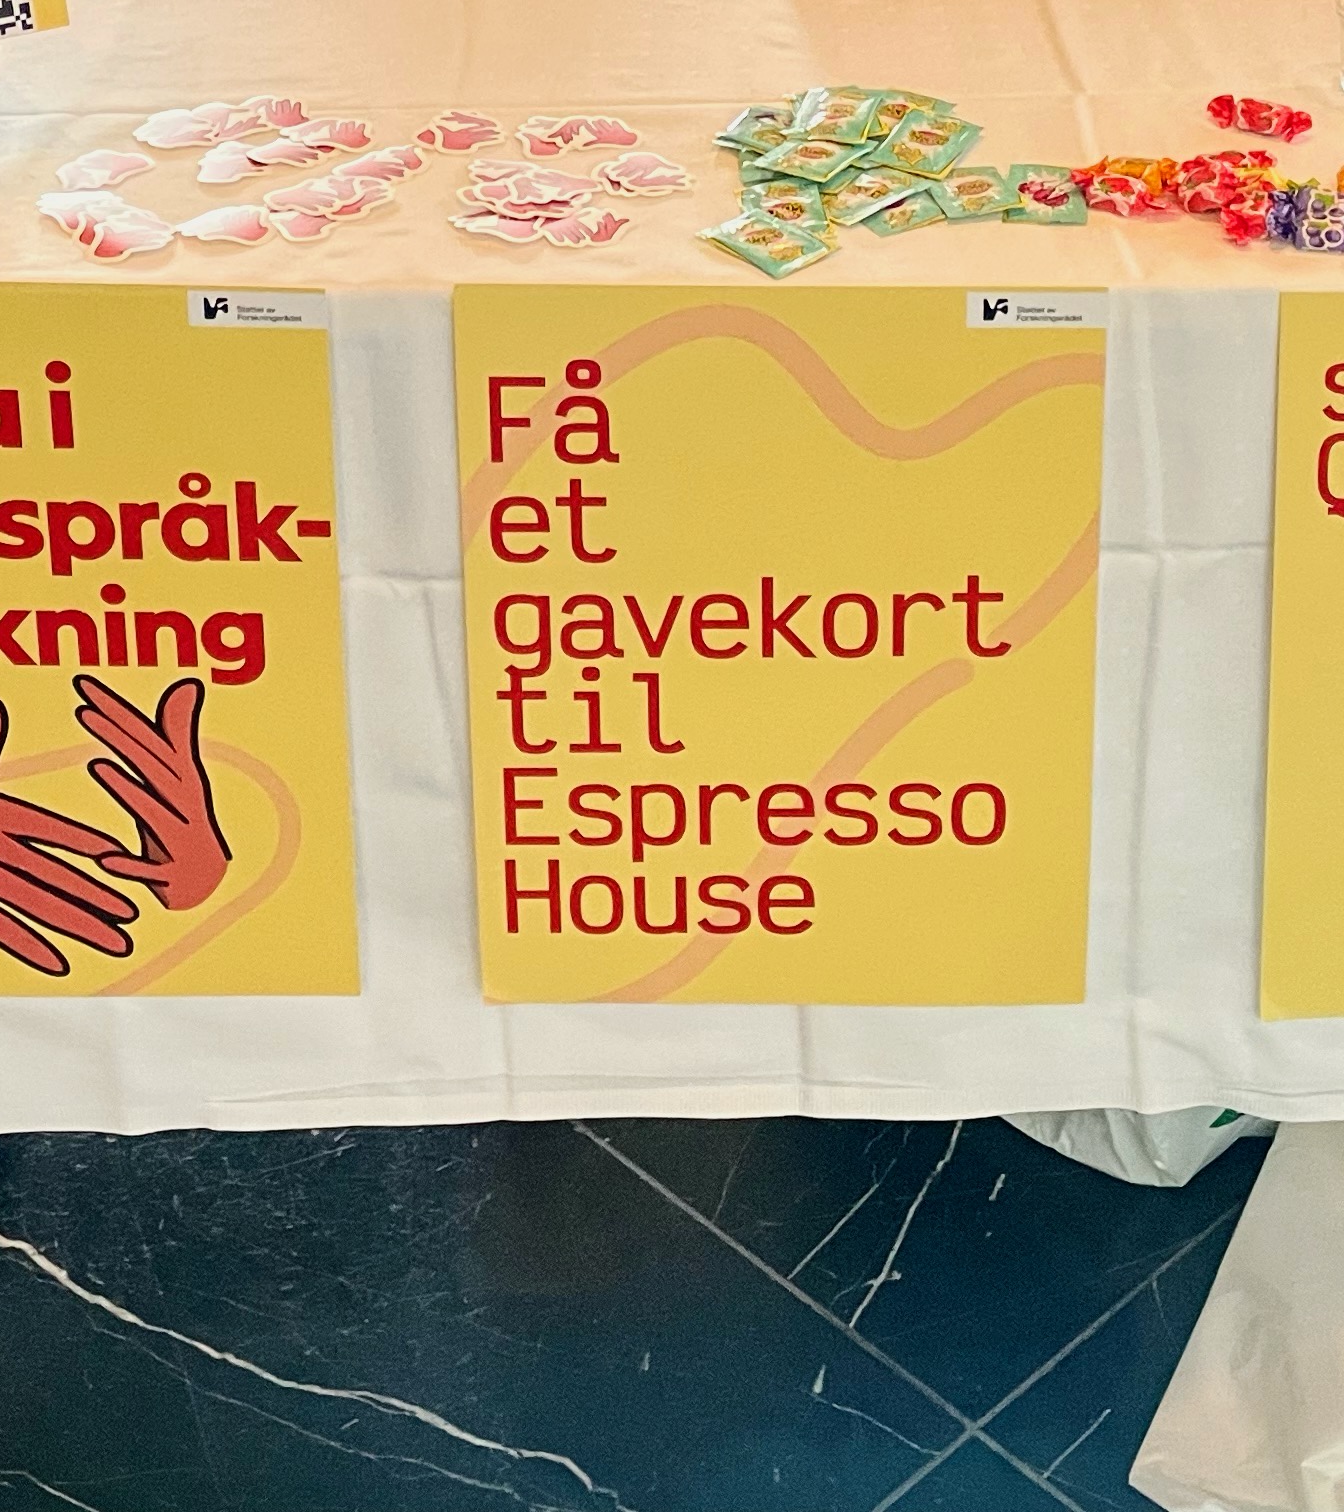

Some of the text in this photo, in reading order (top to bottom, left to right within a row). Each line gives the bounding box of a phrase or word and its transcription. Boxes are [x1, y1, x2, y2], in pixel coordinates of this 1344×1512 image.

[45, 360, 75, 449] i
[488, 358, 620, 464] Få
[489, 478, 617, 564] et
[493, 575, 1013, 678] gavekort
[496, 666, 686, 755] til
[502, 767, 1007, 863] Espresso
[503, 859, 816, 936] House
